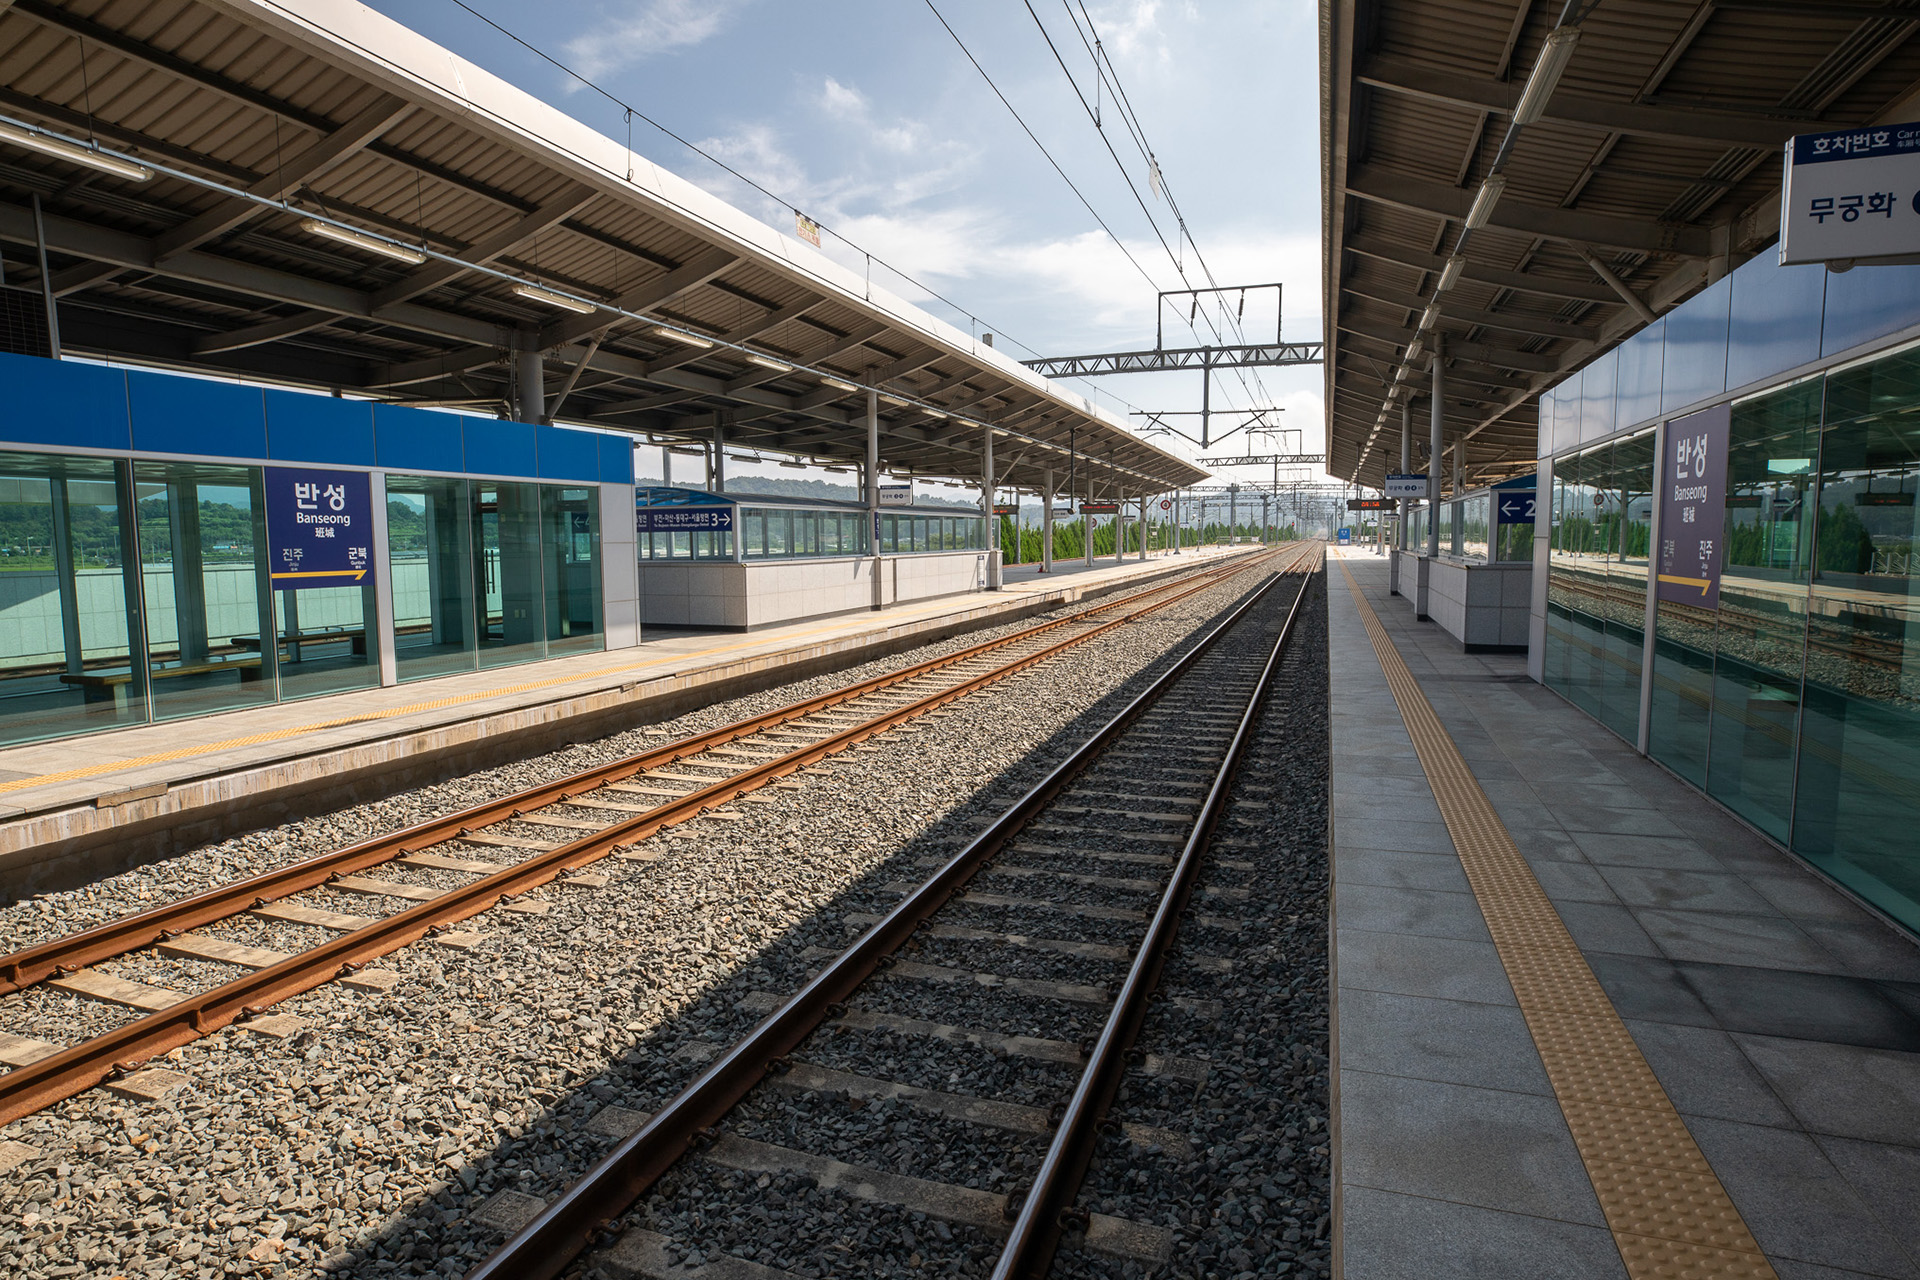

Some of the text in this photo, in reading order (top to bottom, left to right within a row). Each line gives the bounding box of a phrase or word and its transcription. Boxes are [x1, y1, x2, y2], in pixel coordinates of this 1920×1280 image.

[1897, 130, 1914, 139] Car
[1813, 131, 1890, 155] 호차번호
[1809, 192, 1897, 224] 무궁화
[1677, 433, 1708, 479] 반성
[294, 483, 345, 511] 반성
[1674, 485, 1708, 503] Banseong
[1525, 500, 1537, 516] 2
[296, 512, 351, 526] Banseong
[711, 513, 719, 526] 3
[315, 527, 335, 538] 班城
[282, 548, 303, 561] 진주
[348, 547, 367, 560] 군북
[1699, 540, 1713, 560] 진주
